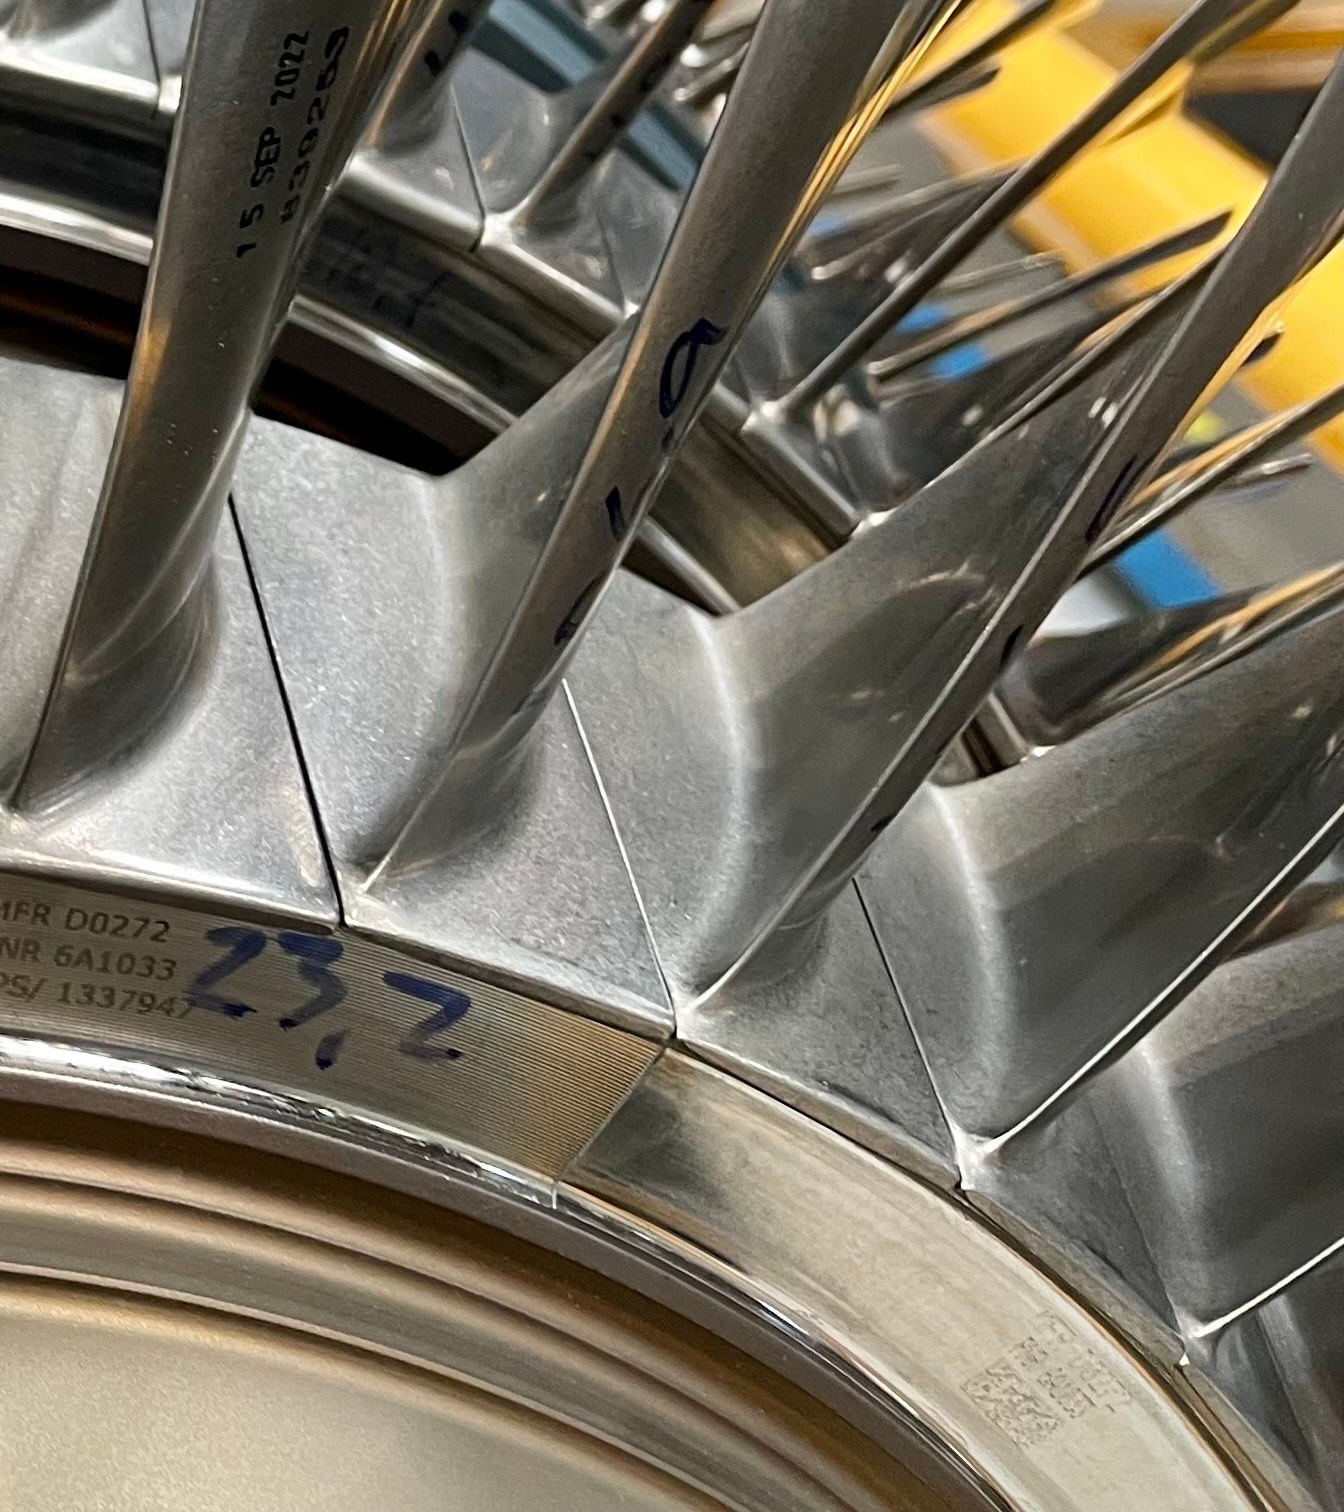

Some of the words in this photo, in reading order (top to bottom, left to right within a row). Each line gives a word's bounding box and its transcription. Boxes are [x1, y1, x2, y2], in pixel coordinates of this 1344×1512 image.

[249, 126, 283, 186] SEP
[270, 29, 310, 108] 2022
[52, 944, 178, 984] 6A1033
[64, 904, 170, 945] D0272
[183, 924, 473, 1070] 23,2
